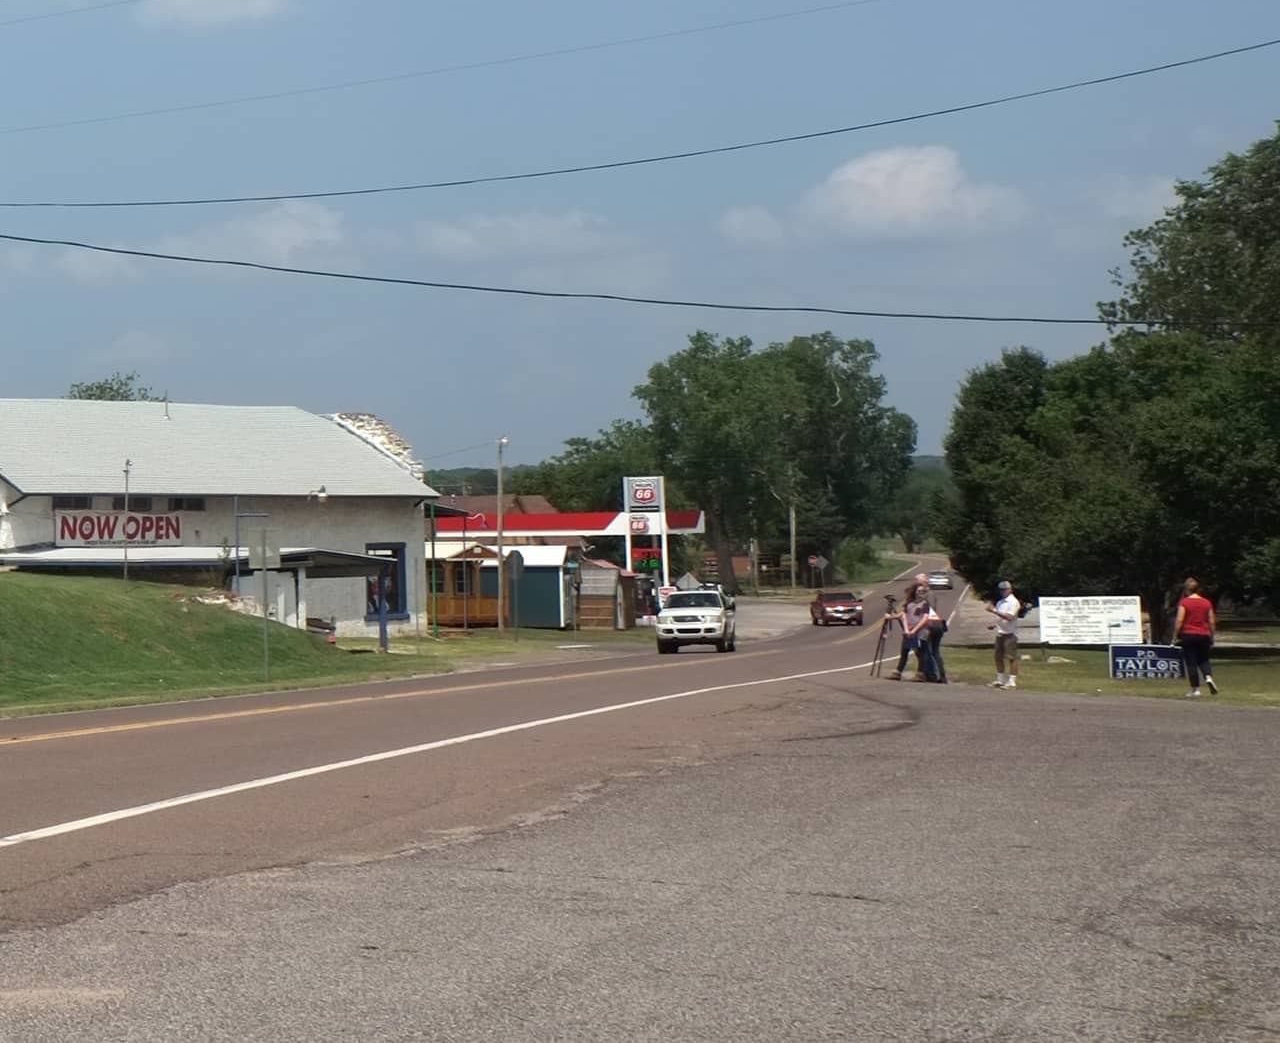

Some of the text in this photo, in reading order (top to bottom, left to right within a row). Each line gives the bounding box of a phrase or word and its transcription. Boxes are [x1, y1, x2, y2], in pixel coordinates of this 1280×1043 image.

[636, 489, 651, 499] 66
[60, 516, 180, 540] NOW OPEN
[1115, 659, 1180, 671] TAYLOR
